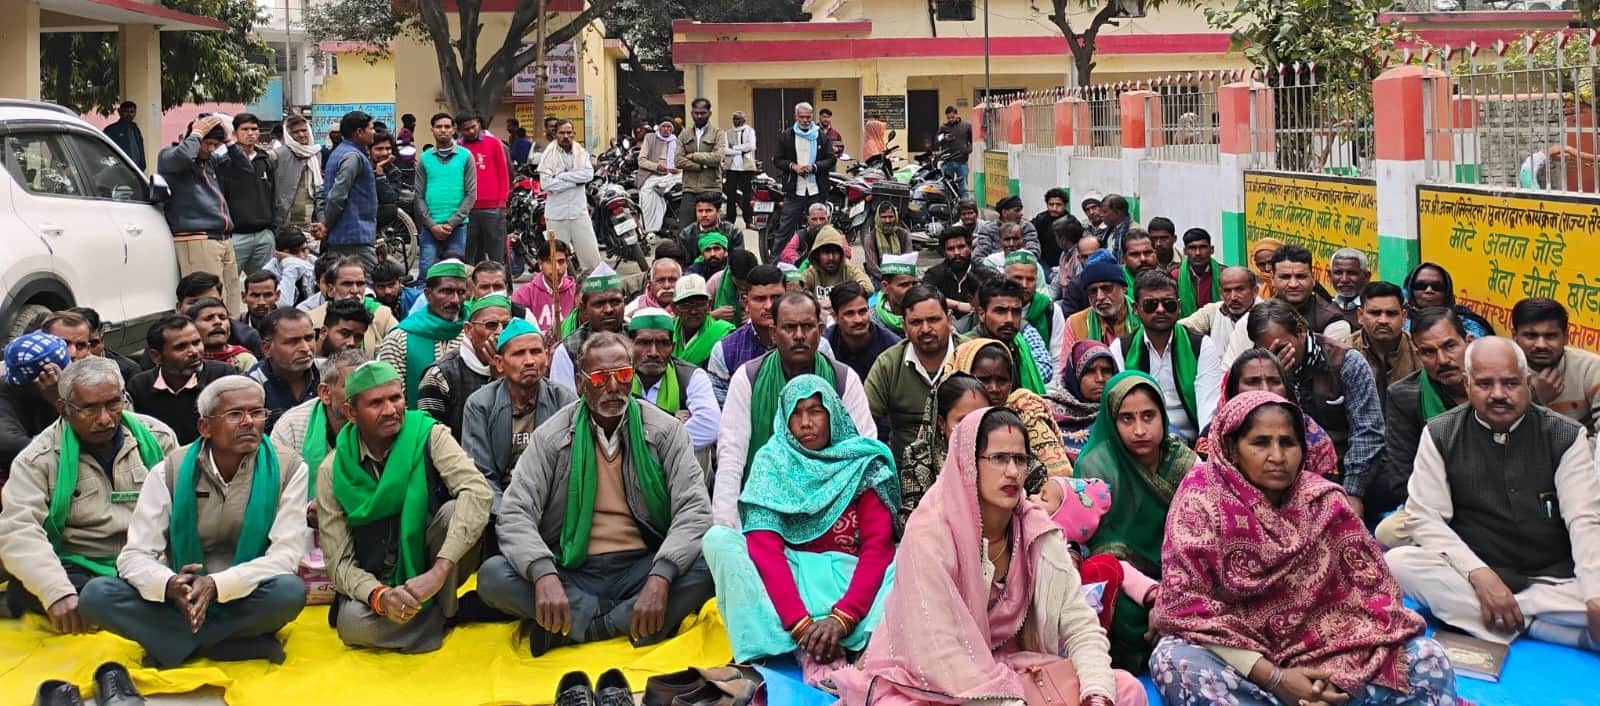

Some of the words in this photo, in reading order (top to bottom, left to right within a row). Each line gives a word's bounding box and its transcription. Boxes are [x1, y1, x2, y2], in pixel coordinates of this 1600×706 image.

[1449, 222, 1478, 252] मोटे
[1482, 232, 1530, 260] अनाज
[1487, 260, 1516, 298] मैदा
